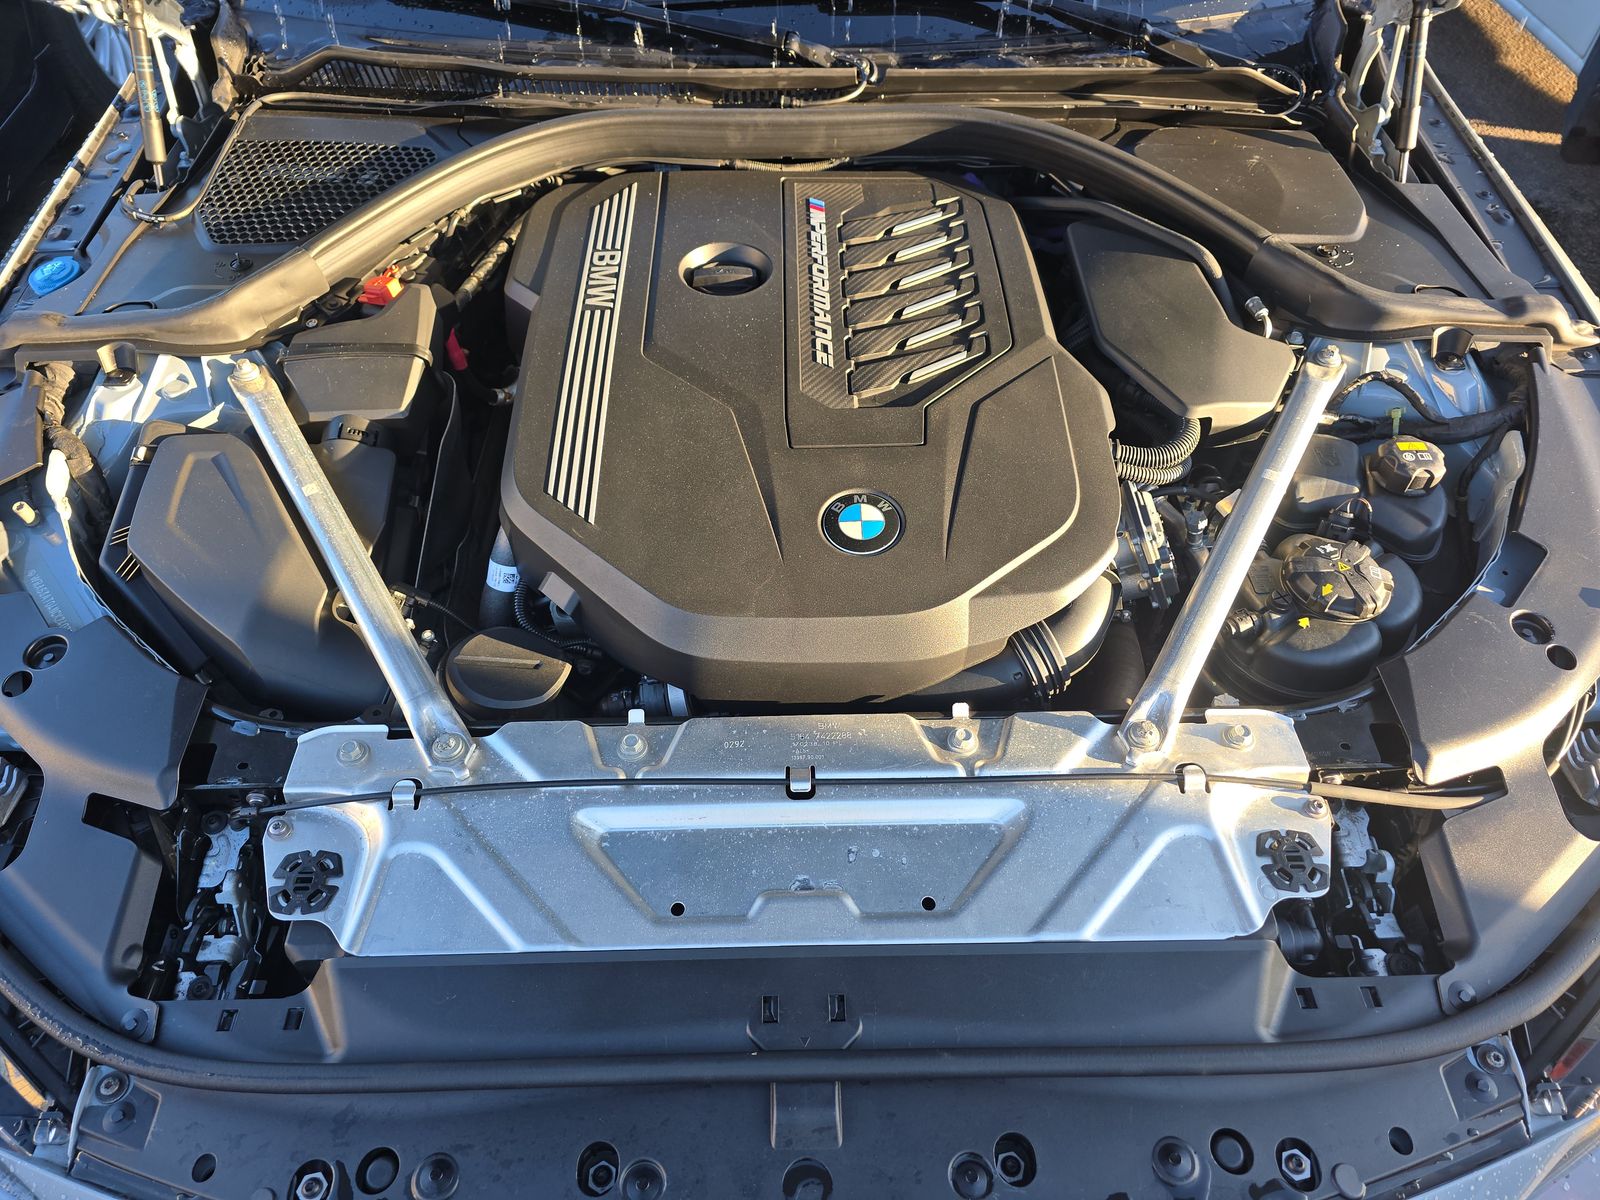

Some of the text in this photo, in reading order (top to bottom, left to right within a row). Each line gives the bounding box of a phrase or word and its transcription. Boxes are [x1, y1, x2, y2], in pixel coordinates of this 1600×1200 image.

[584, 250, 622, 309] BMW
[810, 221, 834, 368] PERFORMANCE
[830, 494, 893, 514] BMW
[723, 740, 745, 749] 0292
[814, 731, 852, 740] 7422288
